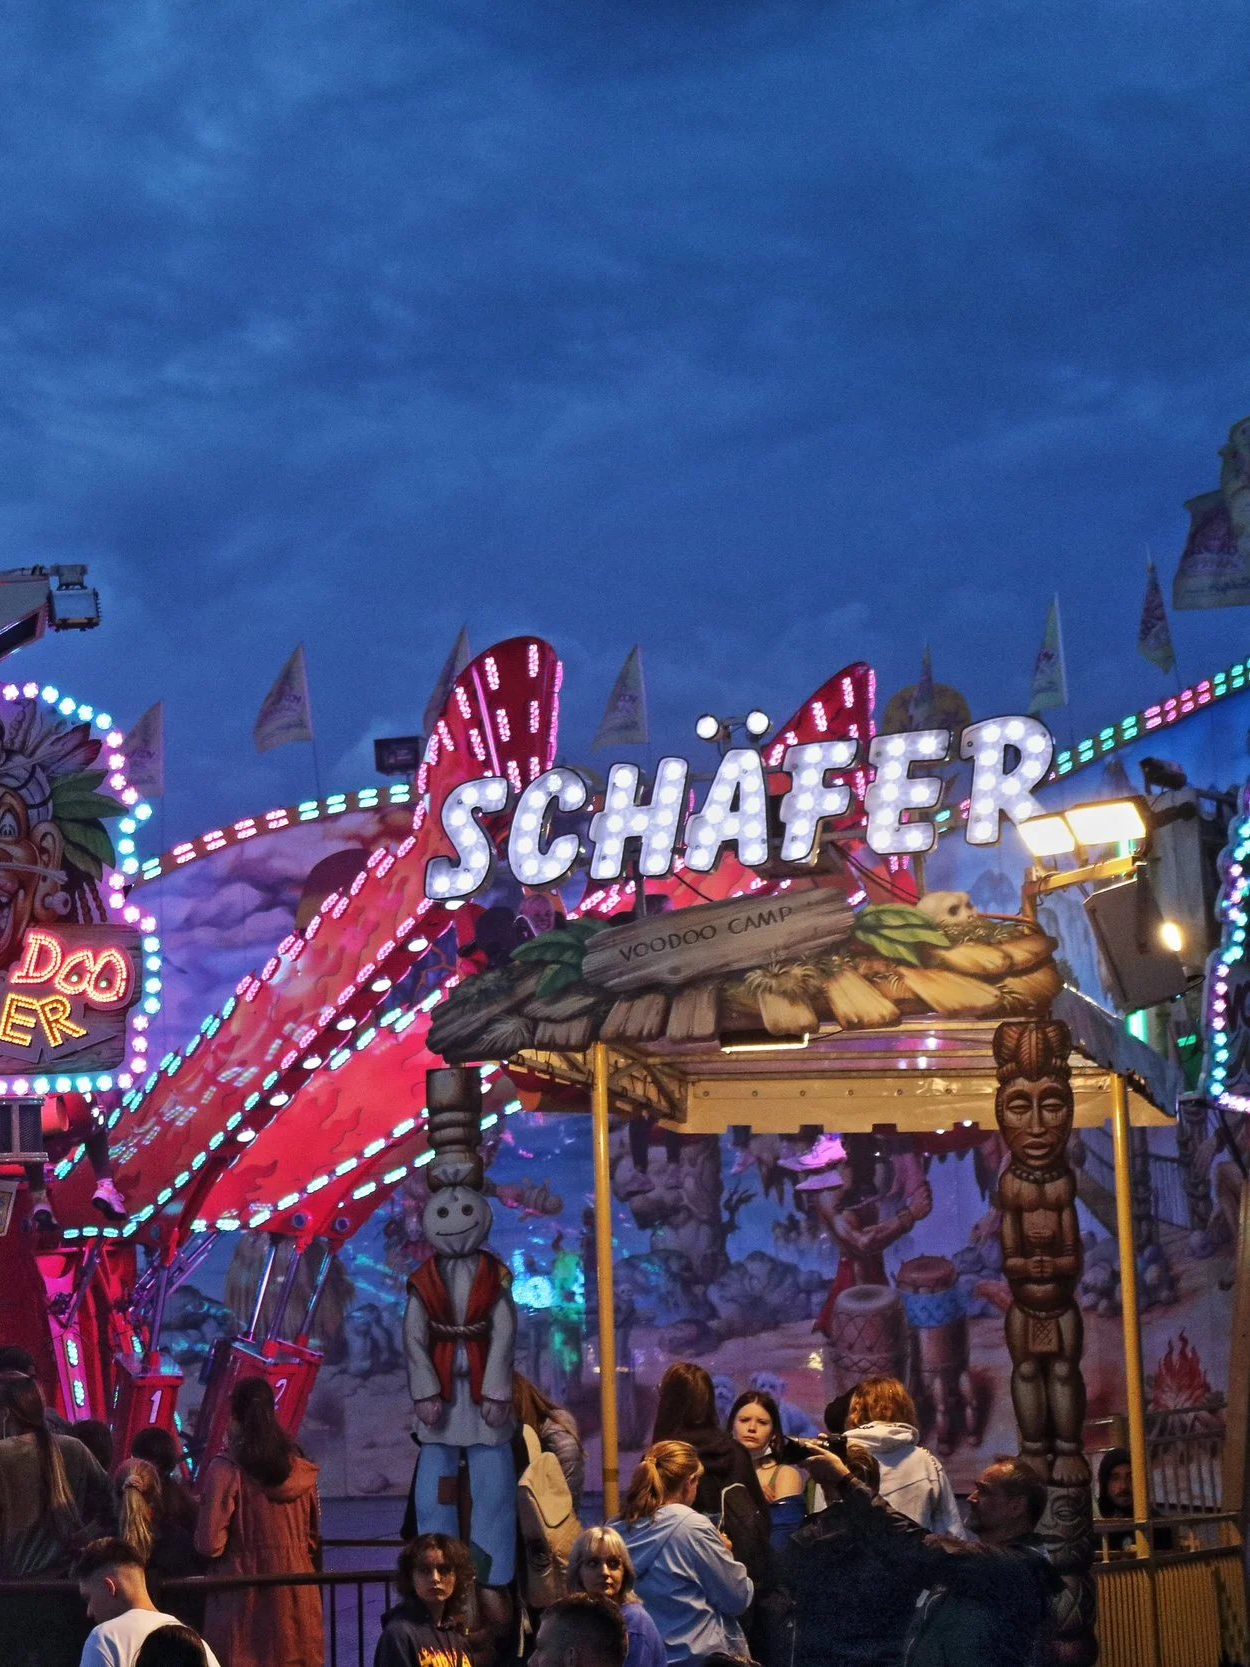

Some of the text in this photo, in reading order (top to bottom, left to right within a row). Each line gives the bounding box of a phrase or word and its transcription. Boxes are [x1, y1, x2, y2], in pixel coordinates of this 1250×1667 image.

[424, 711, 1054, 900] SCHÄFER
[10, 933, 127, 1003] DOO
[619, 906, 793, 962] VOODOO CAMP
